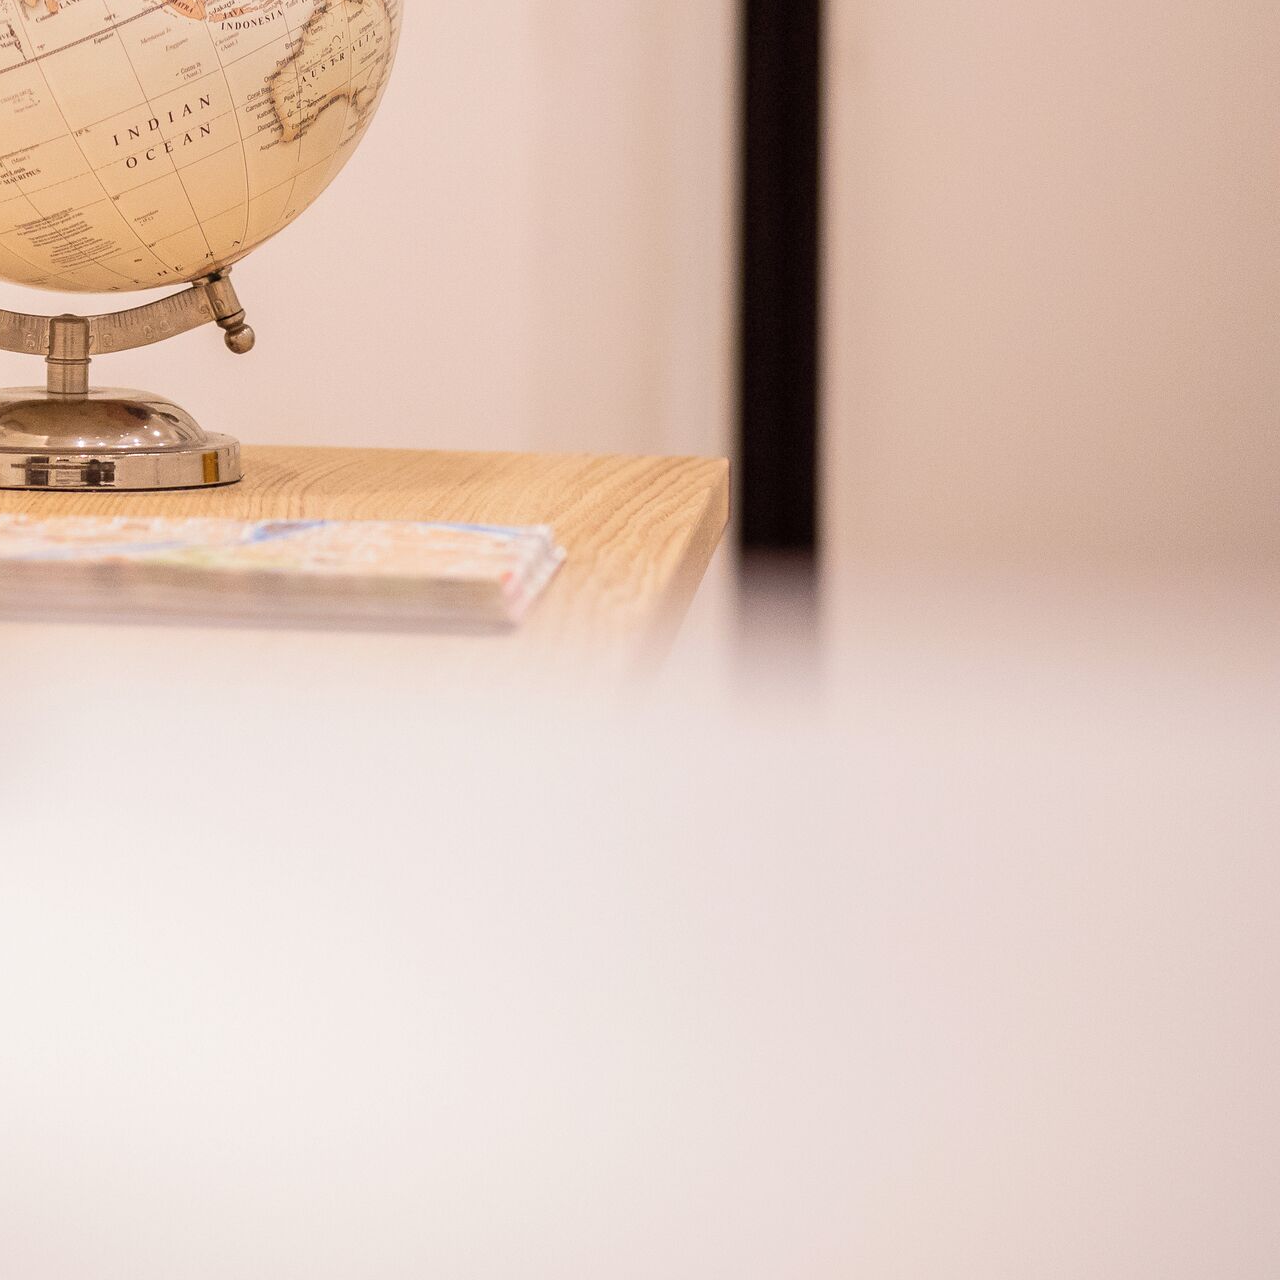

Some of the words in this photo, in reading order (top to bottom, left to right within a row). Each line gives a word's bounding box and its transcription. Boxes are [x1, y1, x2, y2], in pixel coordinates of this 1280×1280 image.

[220, 10, 284, 31] INDONESIA
[301, 29, 377, 82] AUSTRALIA
[113, 93, 212, 147] INDIAN
[125, 122, 212, 169] OCEAN
